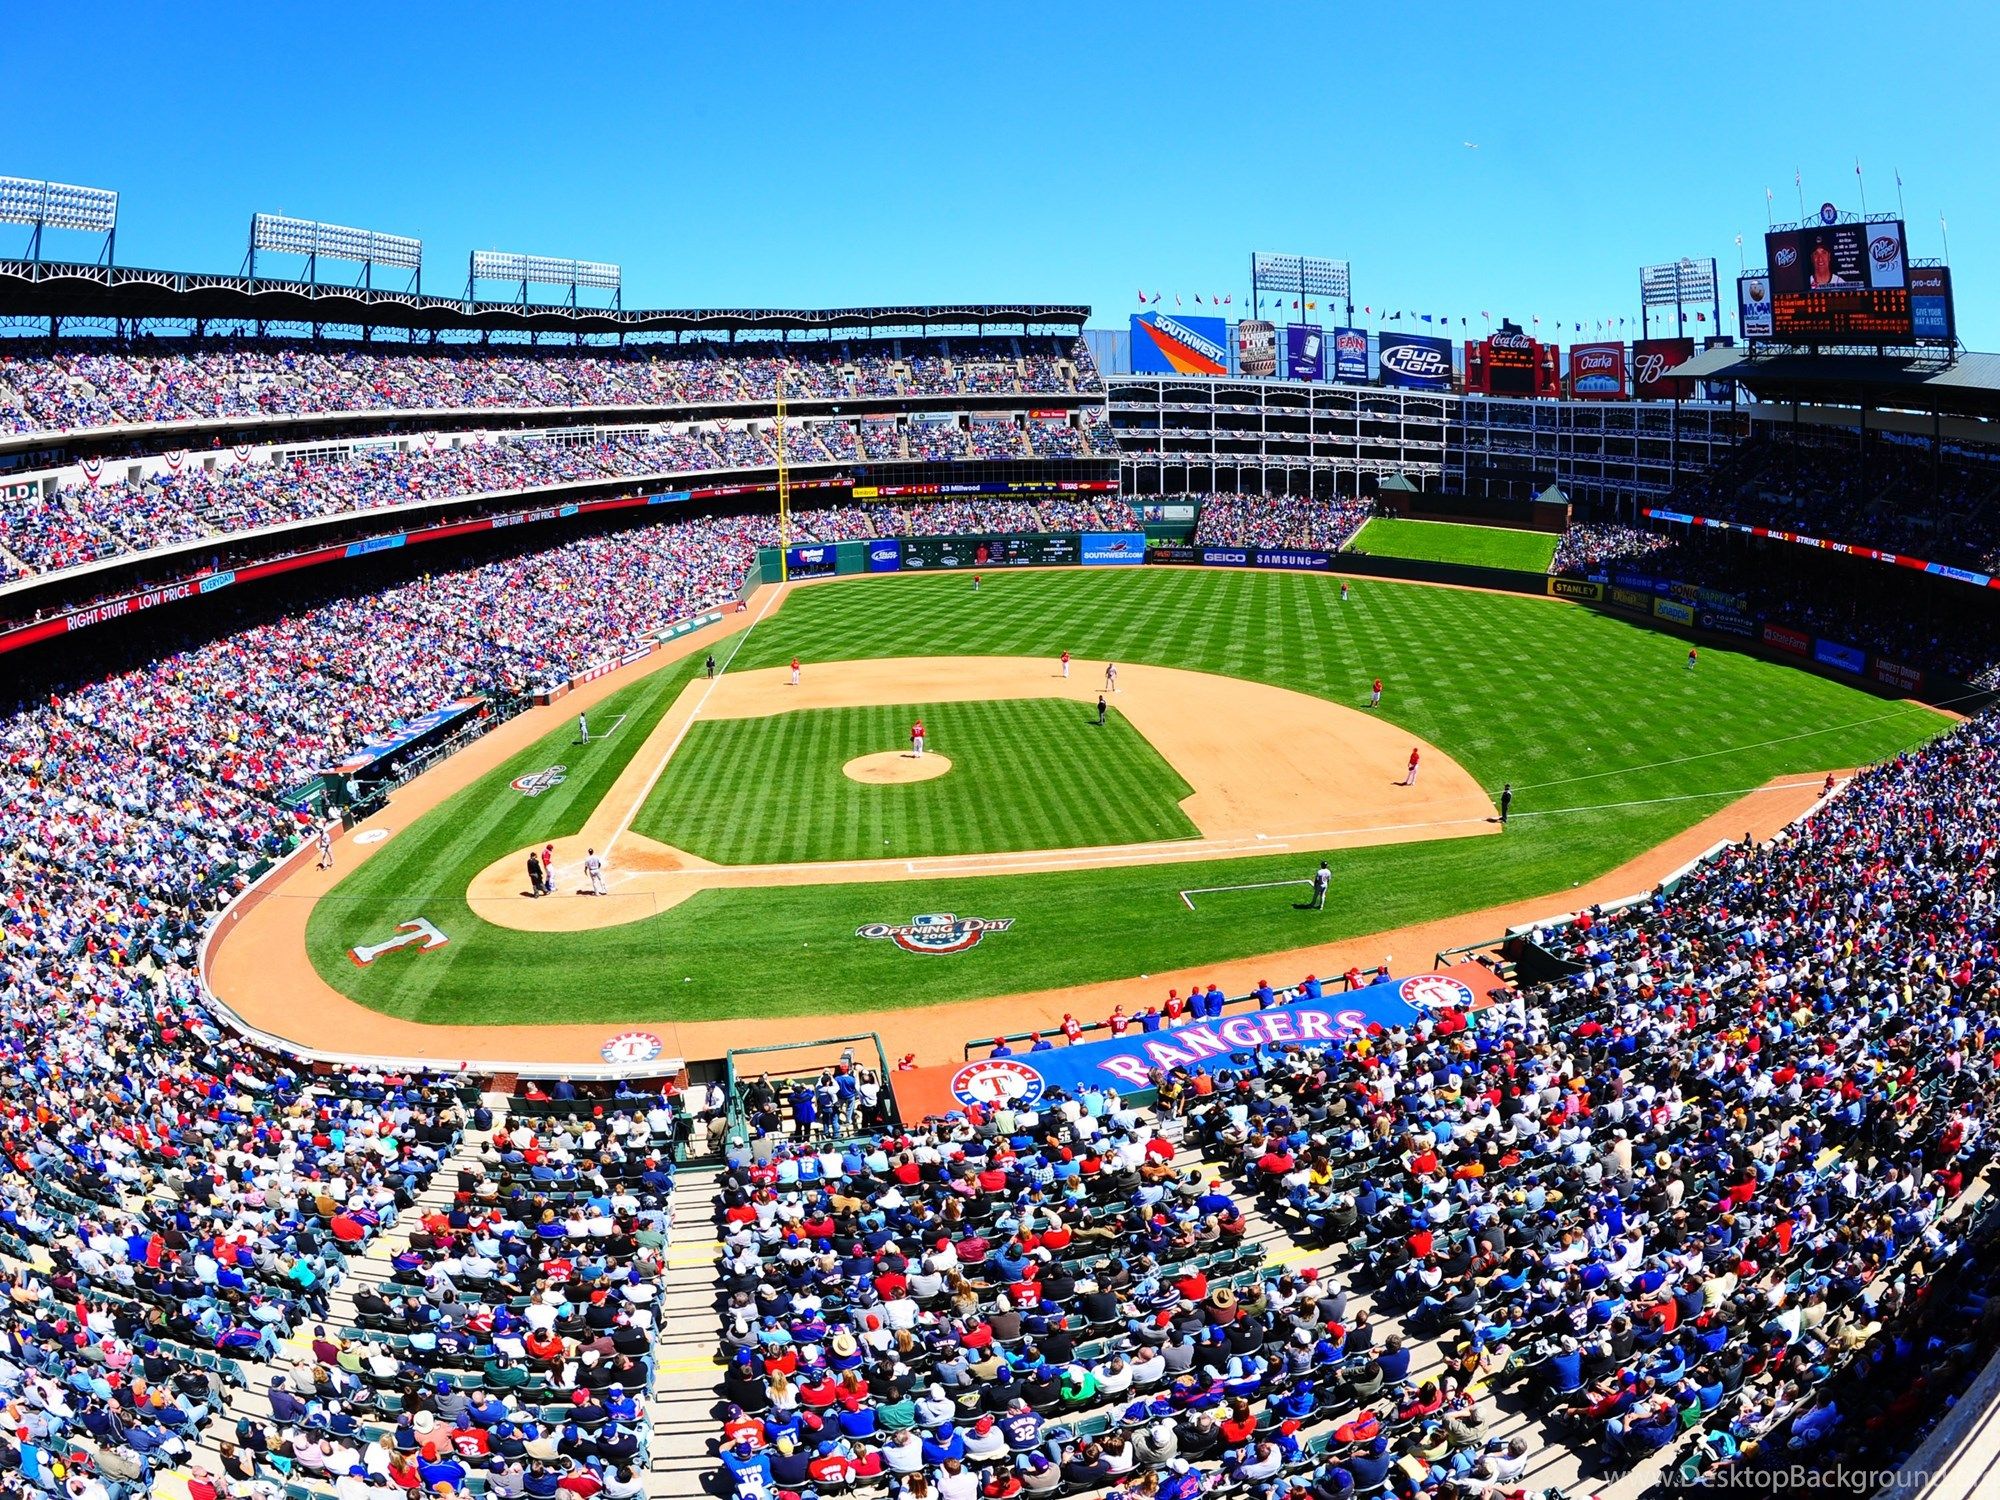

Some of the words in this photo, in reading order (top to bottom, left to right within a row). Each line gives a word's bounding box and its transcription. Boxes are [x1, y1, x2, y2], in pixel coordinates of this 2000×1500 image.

[1776, 251, 1795, 266] Pepper
[1915, 308, 1927, 316] GIVE
[1928, 308, 1942, 316] YOUR
[1914, 317, 1925, 325] HAT
[1154, 315, 1225, 362] SOUTHWEST
[1240, 330, 1275, 341] RANGERS
[1246, 340, 1269, 348] LIVE
[1339, 336, 1364, 350] FAN
[1396, 348, 1442, 363] BUD
[1581, 355, 1613, 370] Ozarka
[1388, 357, 1450, 374] LIGHT
[950, 484, 980, 492] Millwood
[492, 519, 509, 529] RIGHT
[509, 517, 525, 526] STUFF.
[528, 513, 539, 522] LOW
[1767, 530, 1784, 539] BALL
[1796, 535, 1820, 547] STRIKE
[1820, 540, 1826, 548] 2
[367, 539, 393, 550] Academy
[1832, 543, 1847, 552] OUT
[1084, 551, 1143, 559] SOUTHWEST.COM
[1204, 553, 1246, 562] GEICO
[1257, 555, 1312, 566] SAMSUNG
[1947, 567, 1975, 581] Academy
[1556, 583, 1595, 595] STANLEY
[1616, 576, 1653, 588] SAMSUNG
[1670, 583, 1697, 599] SONIC
[67, 608, 99, 631] RIGHT
[101, 600, 132, 621] STUFF.
[138, 593, 161, 609] LOW
[163, 584, 193, 603] PRICE.
[1659, 603, 1689, 620] Snapple
[1817, 652, 1863, 674] SOUTHWEST.COM
[864, 924, 954, 937] OPENING
[962, 919, 1009, 931] DAY
[348, 917, 450, 967] T
[1421, 986, 1452, 1002] T
[622, 1042, 642, 1056] T
[1098, 1009, 1367, 1088] RANGERS
[960, 1063, 1023, 1080] TEXAS
[979, 1075, 1013, 1097] T
[1058, 1131, 1071, 1141] 56
[802, 1163, 814, 1174] 12
[1017, 1297, 1037, 1307] 34
[1573, 1317, 1588, 1331] 32
[1014, 1429, 1035, 1443] 32
[459, 1443, 479, 1454] 32
